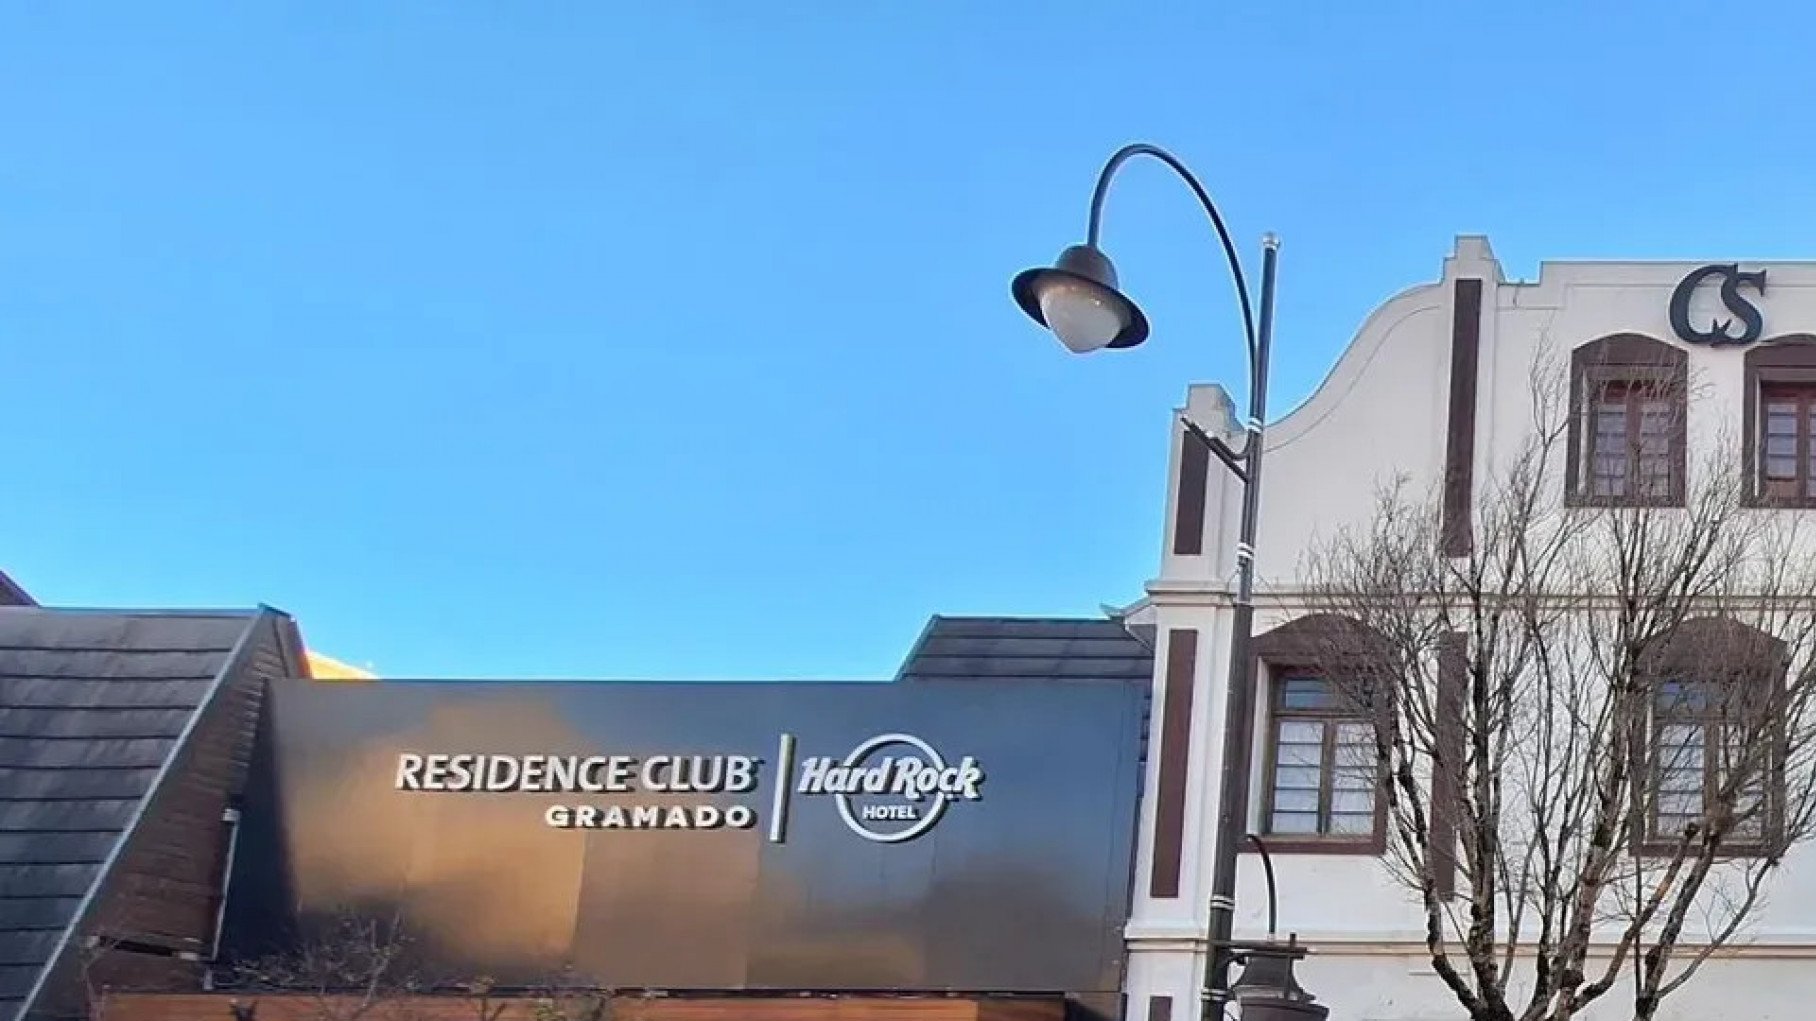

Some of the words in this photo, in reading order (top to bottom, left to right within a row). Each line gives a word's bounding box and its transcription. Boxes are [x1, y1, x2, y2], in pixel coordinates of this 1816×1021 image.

[1669, 262, 1767, 348] CS
[394, 753, 630, 791] RESIDENCE
[641, 755, 752, 791] CLUB
[798, 756, 892, 793] Hard
[892, 756, 983, 799] Rock
[544, 805, 752, 828] GRAMADO
[862, 804, 918, 820] HOTEL
